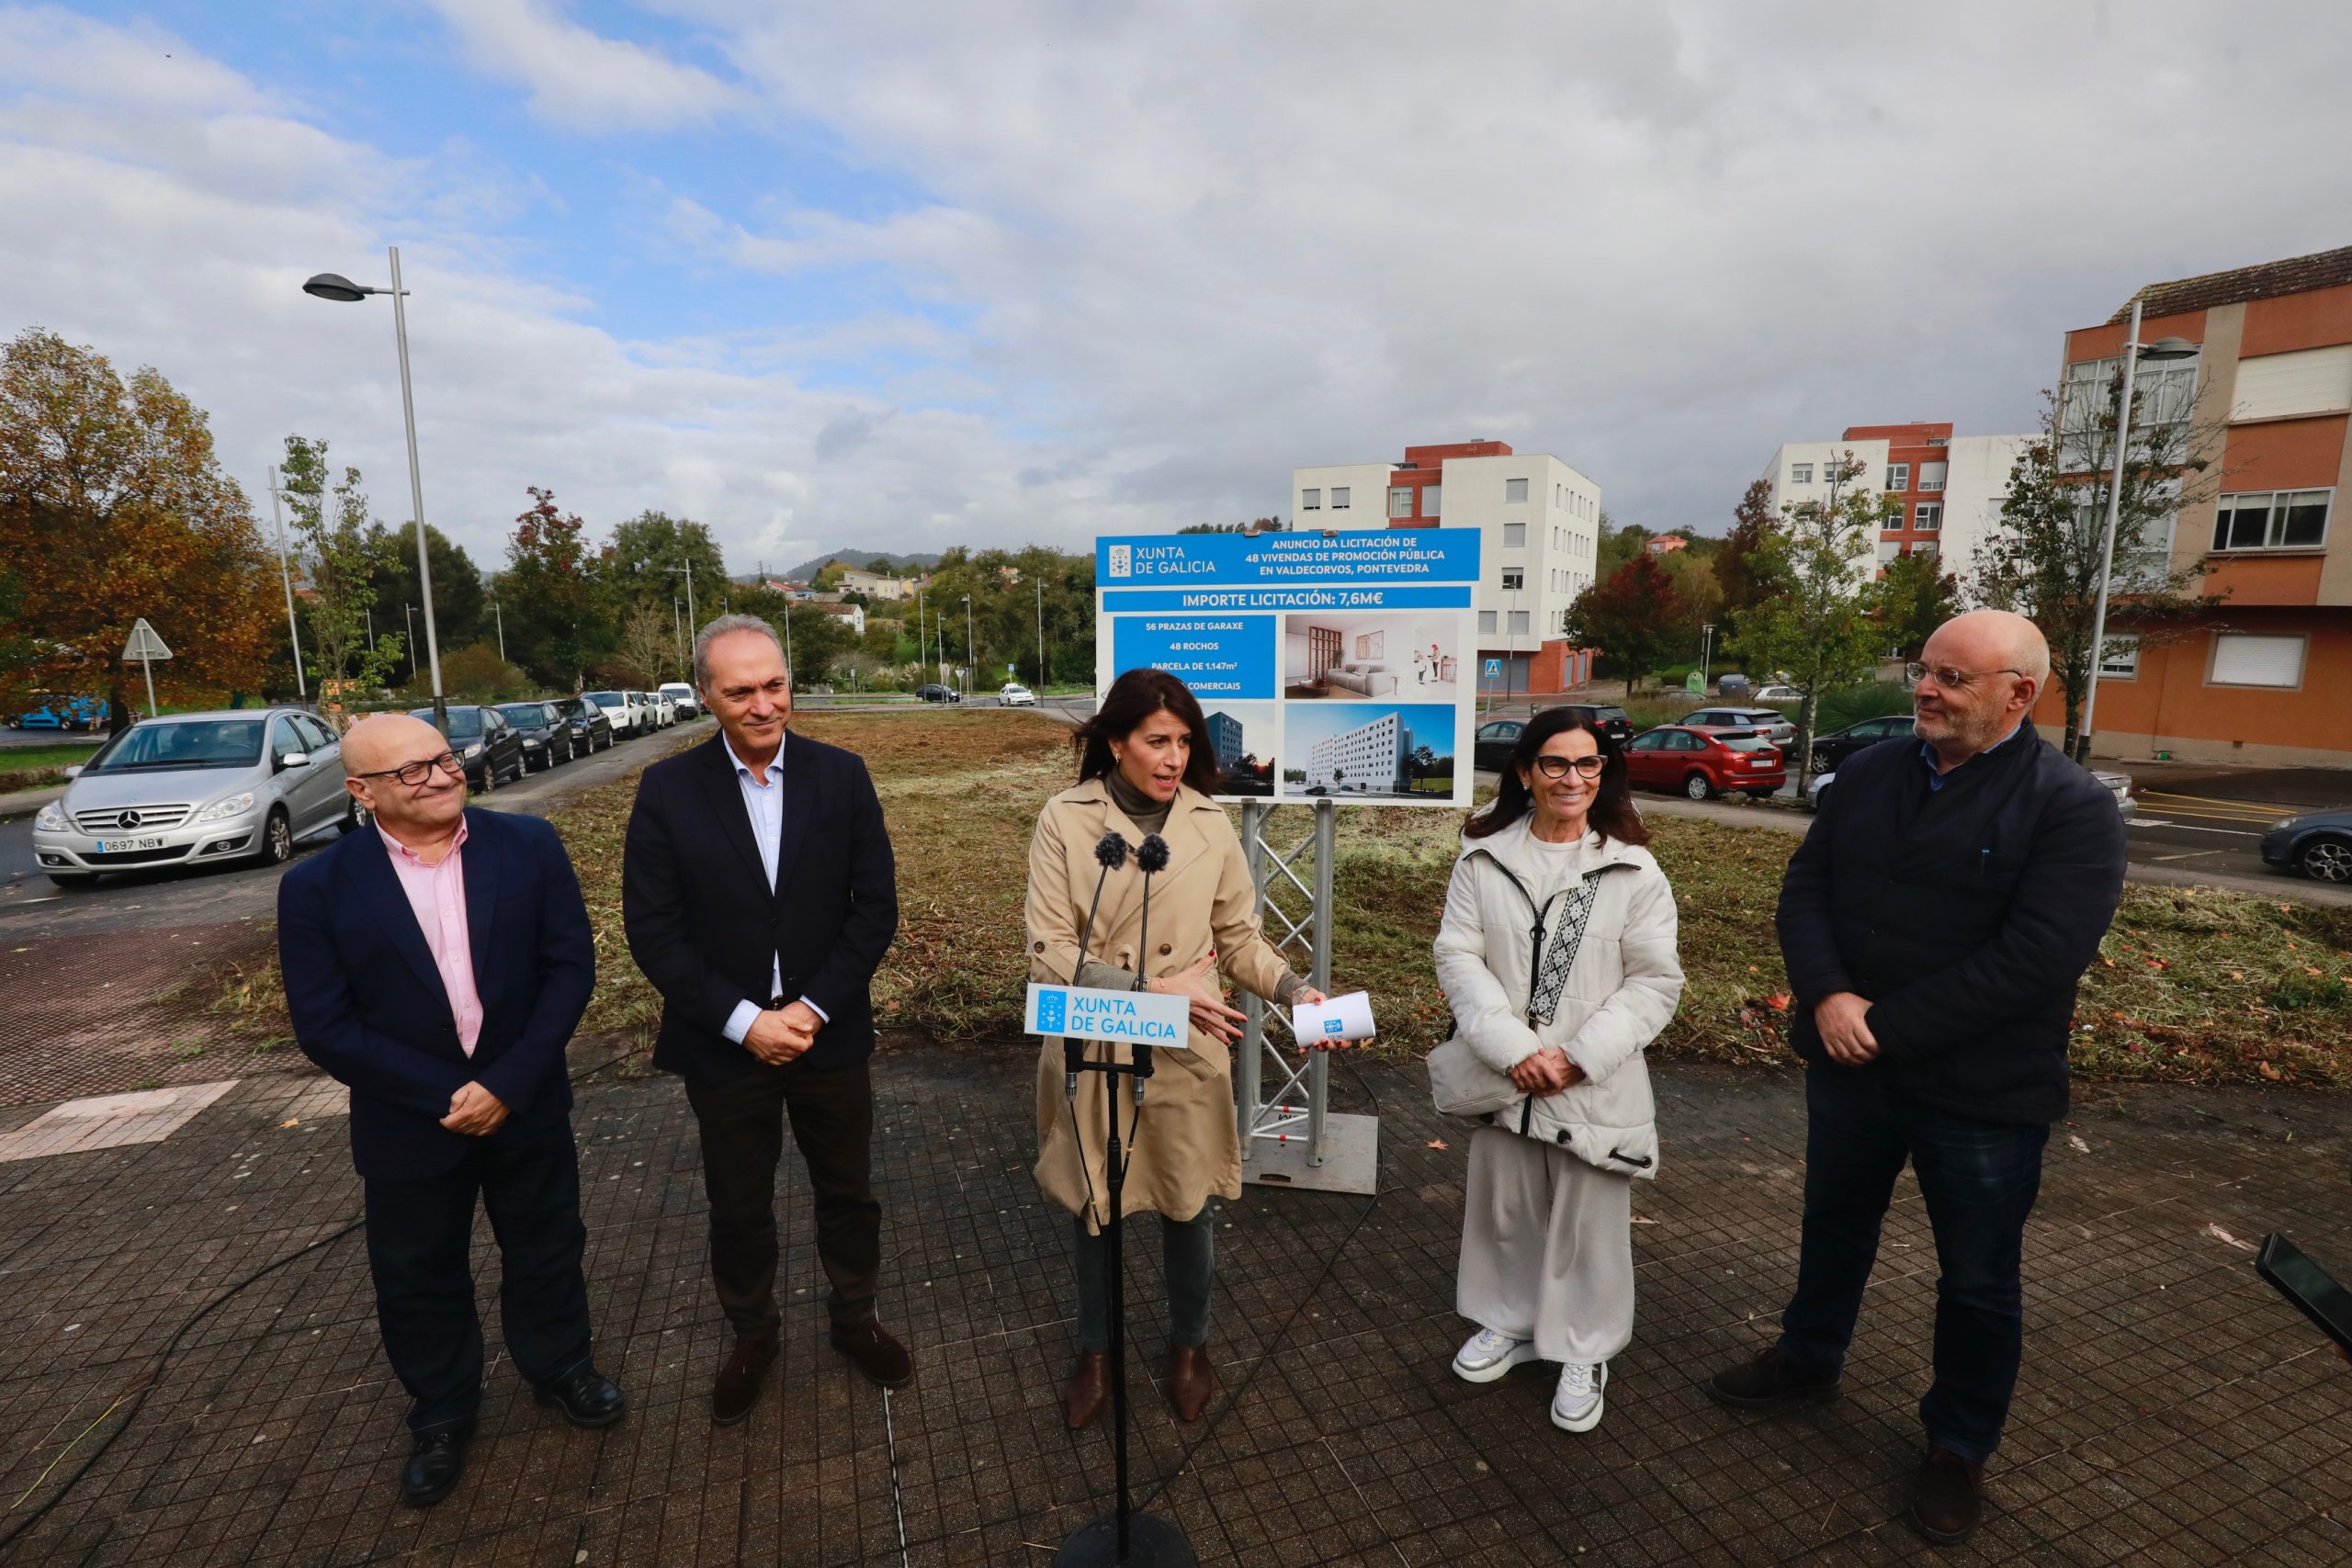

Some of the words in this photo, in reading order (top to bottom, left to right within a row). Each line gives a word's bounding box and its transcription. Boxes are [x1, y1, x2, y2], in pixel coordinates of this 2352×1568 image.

[1272, 539, 1320, 550] ANUNCIO
[1323, 538, 1339, 548] DA
[1340, 536, 1399, 548] LICITACIÓN
[1403, 537, 1418, 547] DE
[1136, 547, 1185, 559] XUNTA
[1245, 553, 1259, 563] 48
[1261, 552, 1313, 562] VIVENDAS
[1316, 552, 1329, 561] DE
[1332, 549, 1397, 561] PROMOCIÓN
[1399, 549, 1445, 559] PÚBLICA
[1136, 561, 1154, 574] DE
[1158, 560, 1216, 573] GALICIA
[1260, 566, 1273, 575] EN
[1276, 564, 1354, 575] VALDECORVOS,
[1357, 563, 1430, 574] PONTEVEDRA
[1182, 594, 1246, 607] IMPORTE
[1250, 590, 1335, 606] LICITACIÓN:
[1339, 592, 1384, 606] 7,6M€
[1146, 623, 1157, 631] 56
[1207, 622, 1243, 630] GARAXE
[1183, 642, 1219, 650] ROCHOS
[1151, 662, 1190, 671] PARCELA
[1188, 682, 1240, 691] COMERCIAIS
[105, 840, 134, 851] 0697
[1073, 997, 1136, 1016] XUNTA
[1071, 1016, 1094, 1032] DE
[1101, 1018, 1176, 1039] GALICIA
